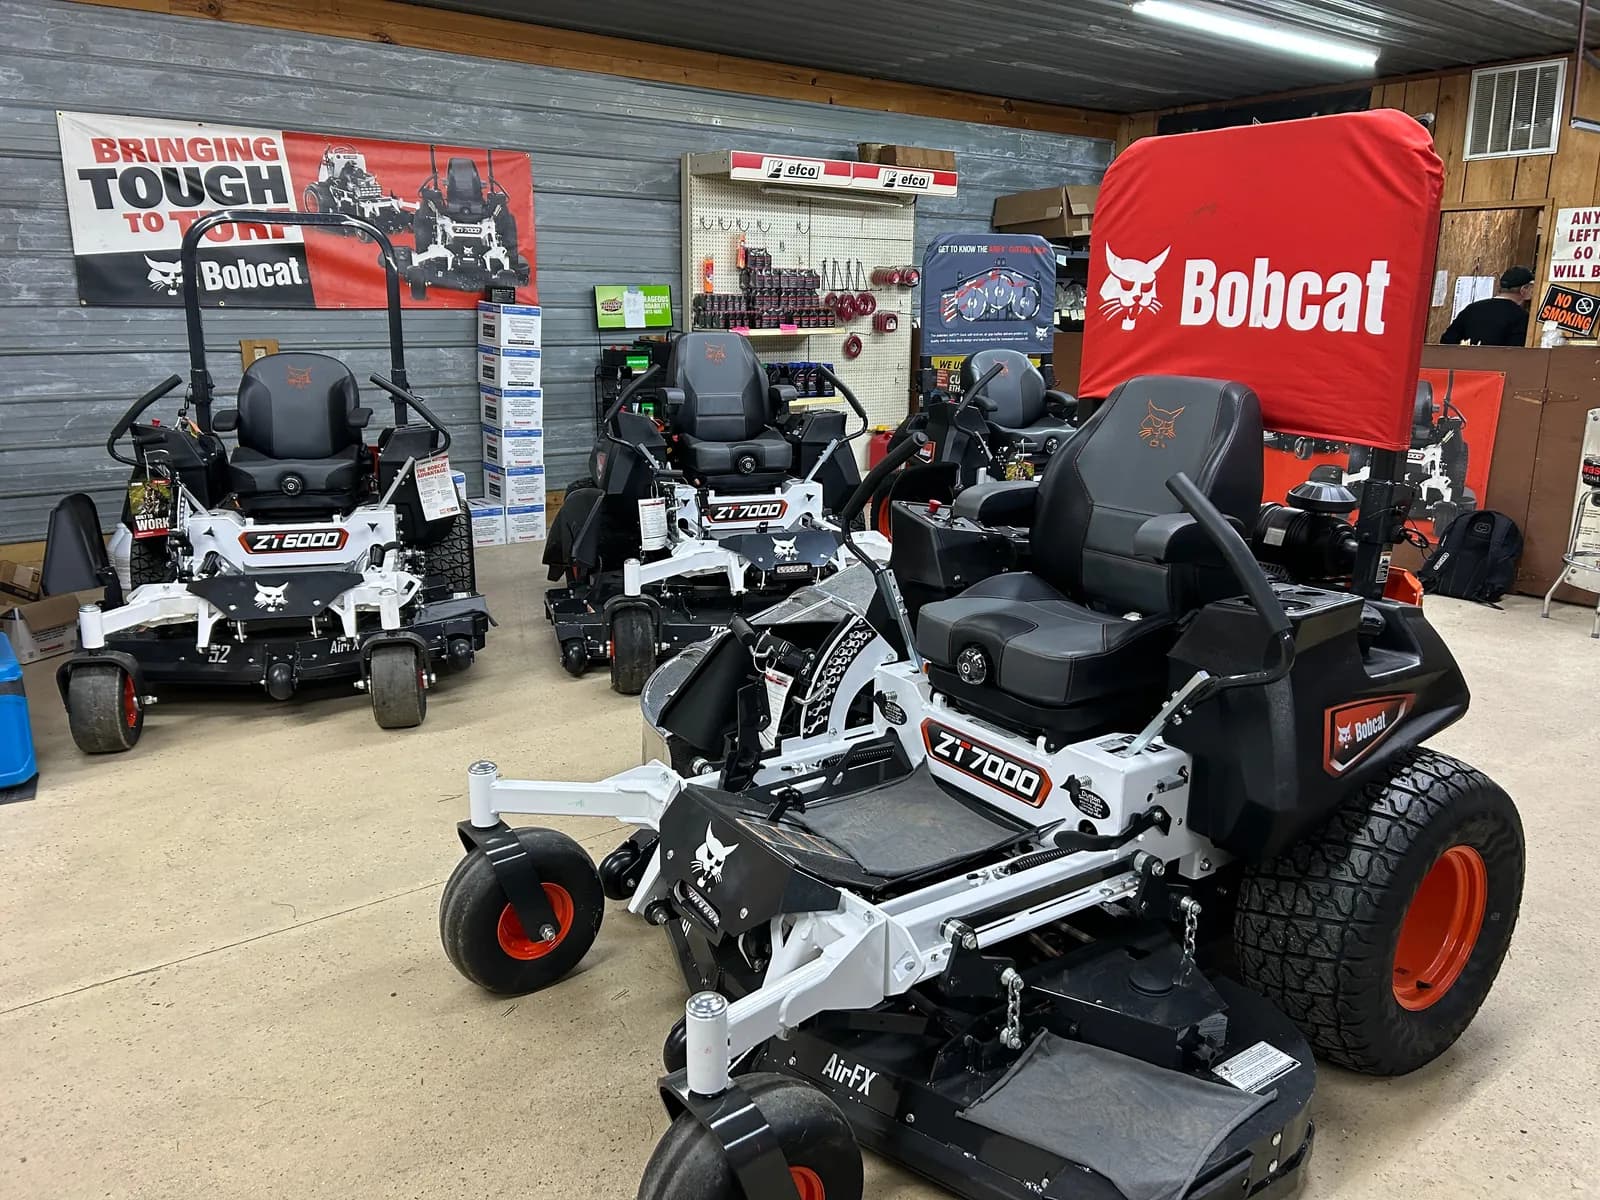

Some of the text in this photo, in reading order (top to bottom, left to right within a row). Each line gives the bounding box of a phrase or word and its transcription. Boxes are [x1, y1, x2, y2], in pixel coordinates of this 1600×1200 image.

[90, 137, 279, 163] BRINGING
[787, 163, 816, 177] efco
[77, 165, 289, 209] TOUGH
[901, 173, 926, 187] efco
[123, 211, 164, 233] TO
[1571, 211, 1600, 225] ANY
[1568, 228, 1600, 242] LEFT
[938, 245, 949, 253] GET
[950, 245, 958, 253] TO
[958, 245, 976, 253] KNOW
[977, 245, 988, 253] THE
[1573, 246, 1593, 260] 60
[200, 257, 303, 291] Bobcat
[1553, 265, 1585, 278] WILL
[1179, 258, 1391, 335] Bobcat
[1554, 292, 1572, 308] NO
[1542, 305, 1592, 330] SMOKING
[940, 360, 951, 369] WE
[714, 503, 782, 520] ZT7000
[136, 517, 170, 531] WORK
[253, 532, 340, 550] ZT6000
[1354, 710, 1386, 743] Bobcat
[934, 731, 1041, 797] ZT7000
[821, 1053, 877, 1097] AirFX
